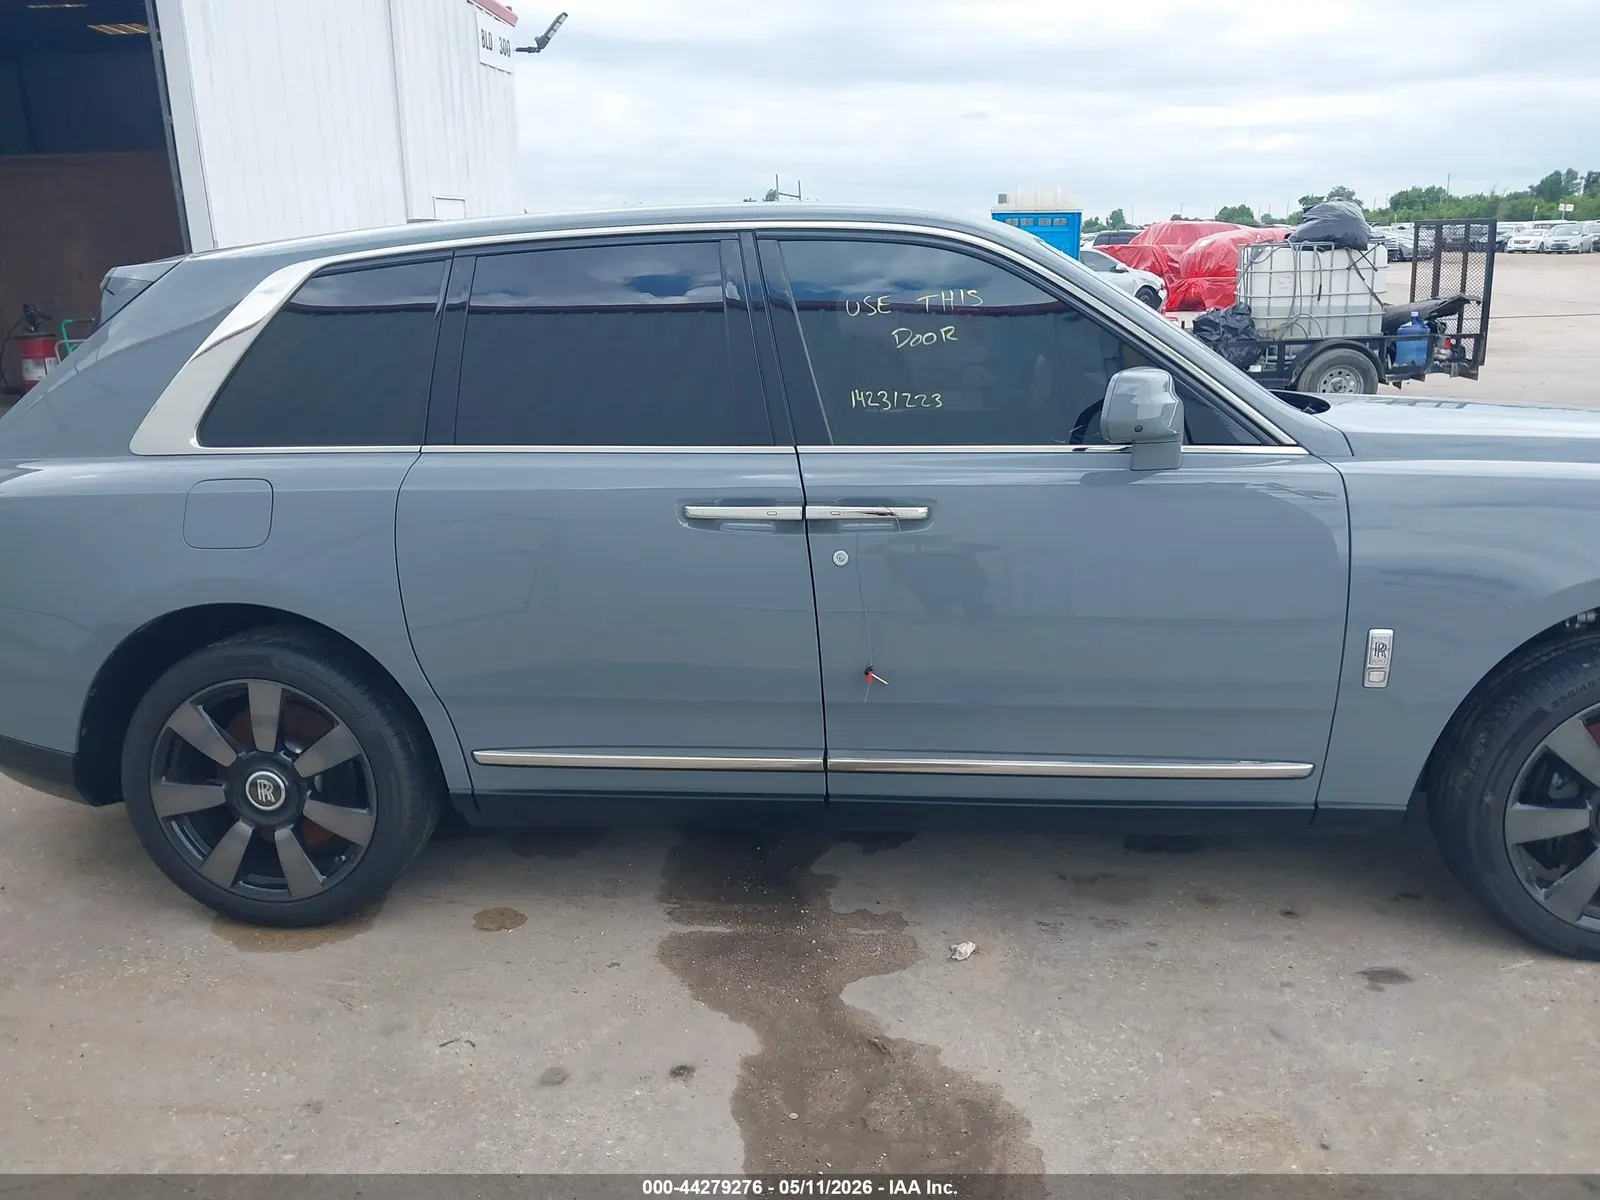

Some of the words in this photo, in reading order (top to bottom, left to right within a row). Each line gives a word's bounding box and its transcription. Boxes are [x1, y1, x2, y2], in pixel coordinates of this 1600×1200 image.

[481, 28, 493, 51] BLD
[499, 36, 511, 58] 300
[845, 295, 892, 317] USE
[916, 289, 984, 313] THIS
[256, 779, 276, 802] RR
